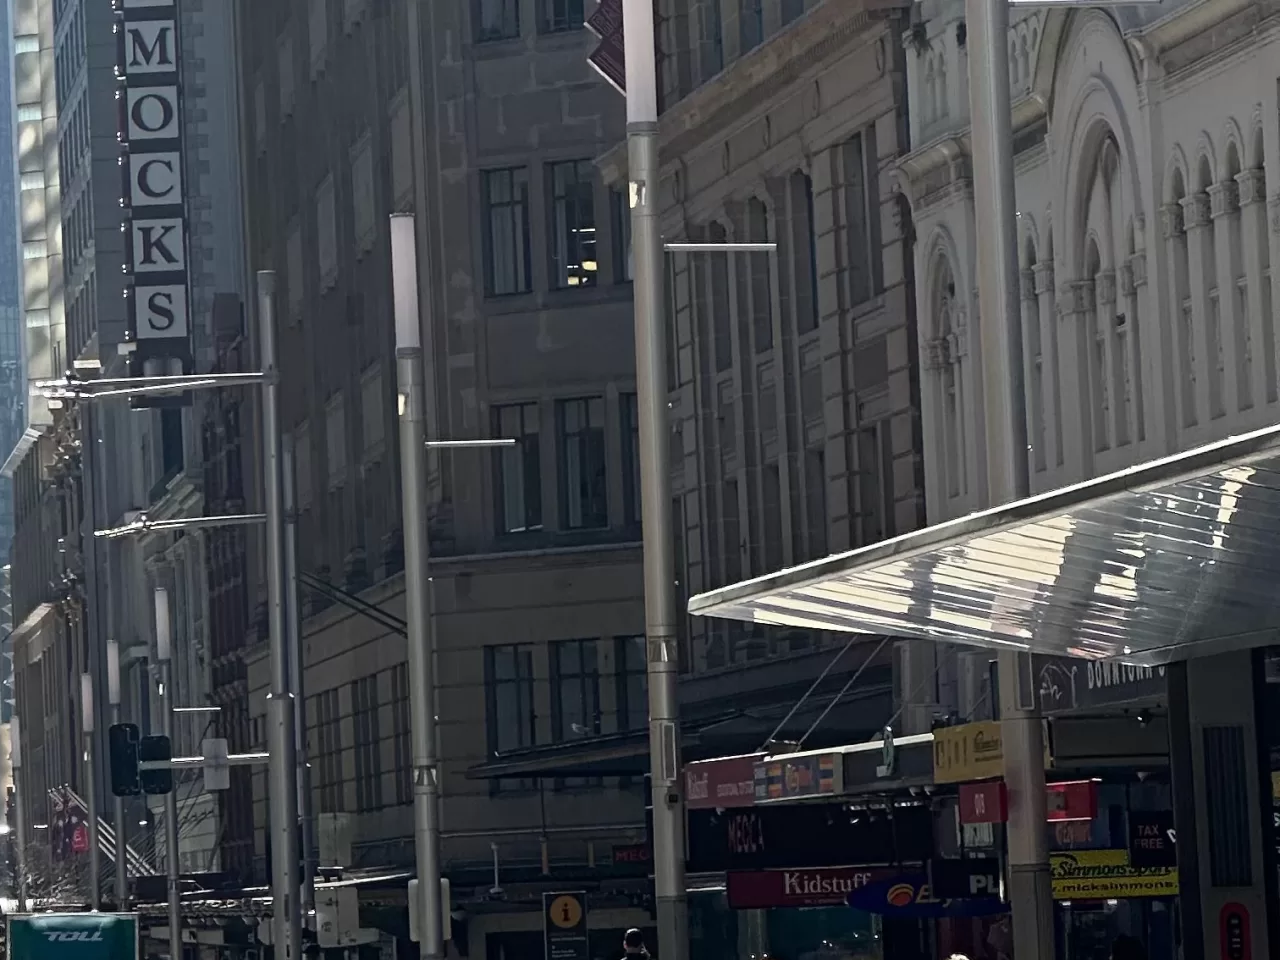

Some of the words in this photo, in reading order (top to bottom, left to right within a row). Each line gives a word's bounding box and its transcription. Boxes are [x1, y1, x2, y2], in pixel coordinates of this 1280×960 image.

[127, 26, 179, 332] MOCKS
[1137, 824, 1159, 836] TAX
[1133, 837, 1164, 849] FREE
[1058, 860, 1127, 877] Simmons
[783, 872, 872, 896] Kidstuff
[42, 931, 104, 942] TOLL
